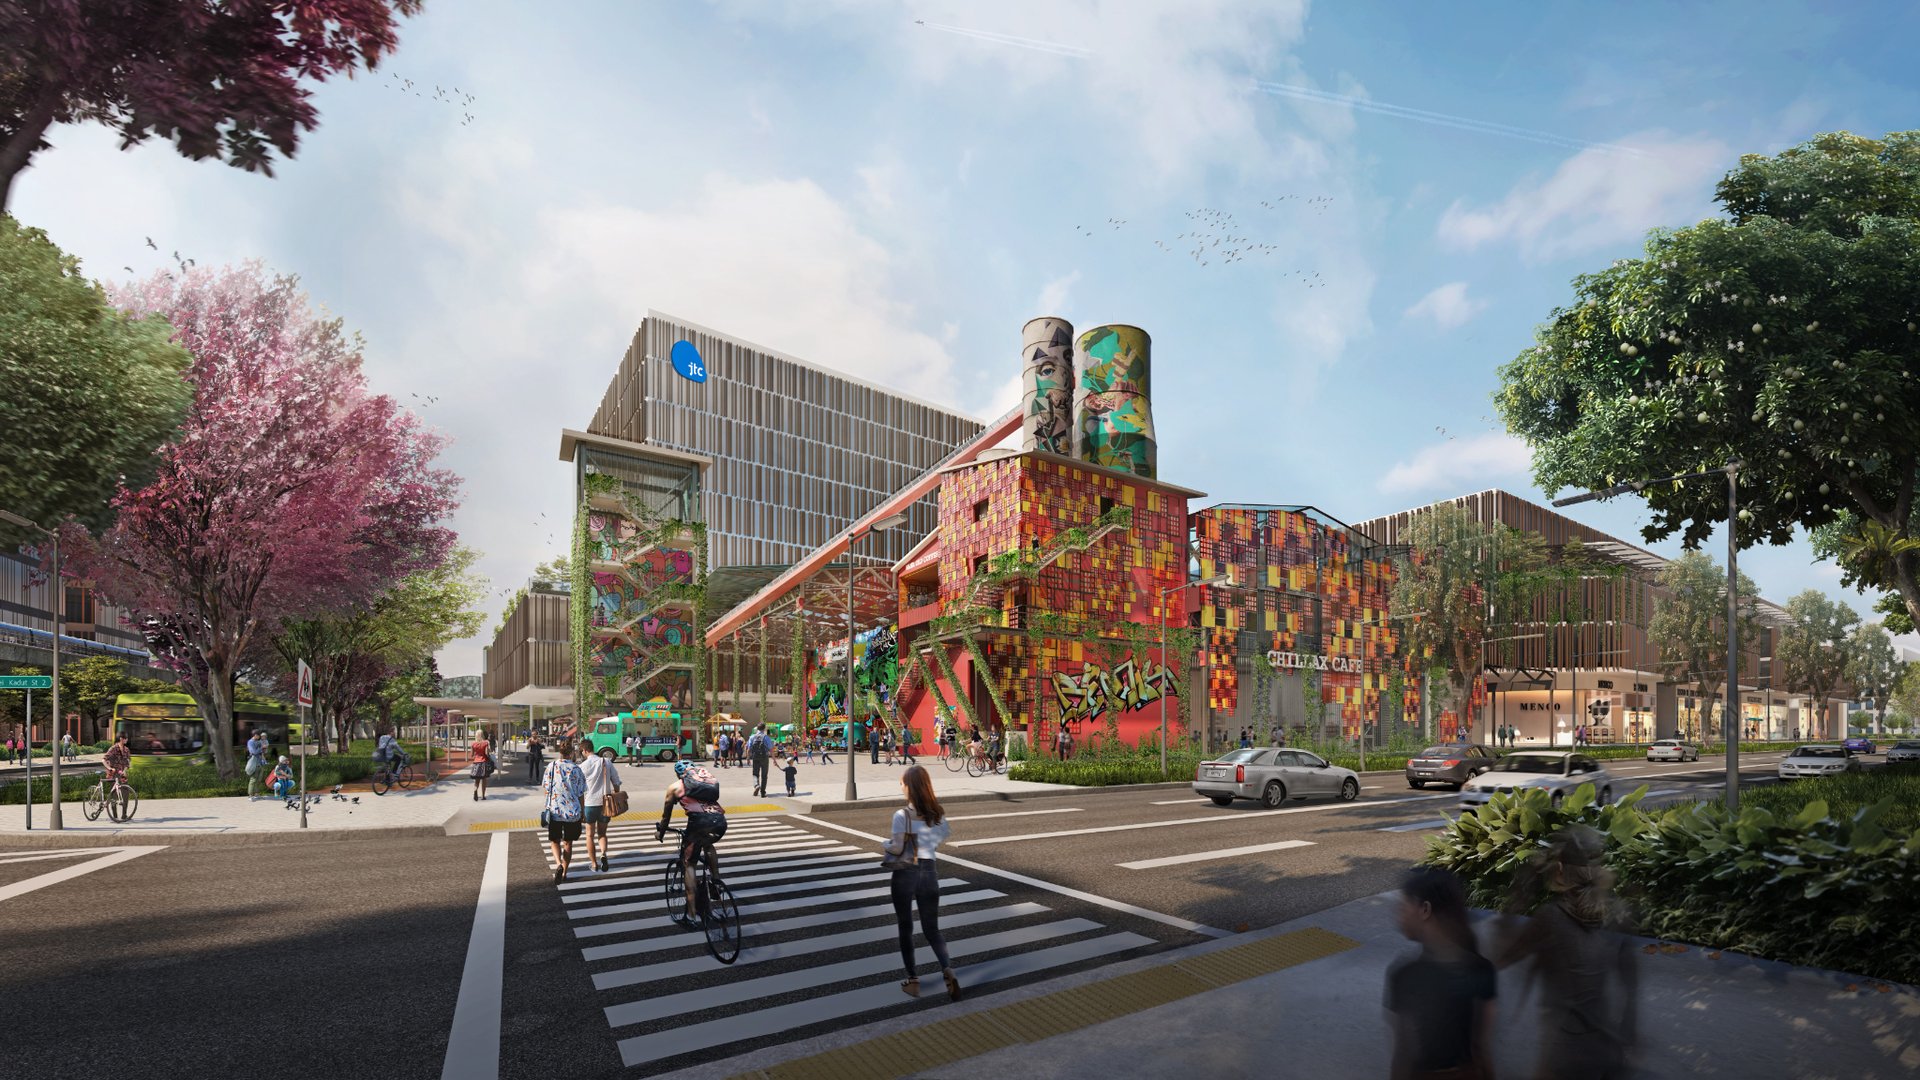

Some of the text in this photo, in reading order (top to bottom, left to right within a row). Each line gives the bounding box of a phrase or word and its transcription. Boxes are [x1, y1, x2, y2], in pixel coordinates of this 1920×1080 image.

[688, 362, 703, 377] jtc
[1267, 650, 1362, 673] CHILLAX CAFE
